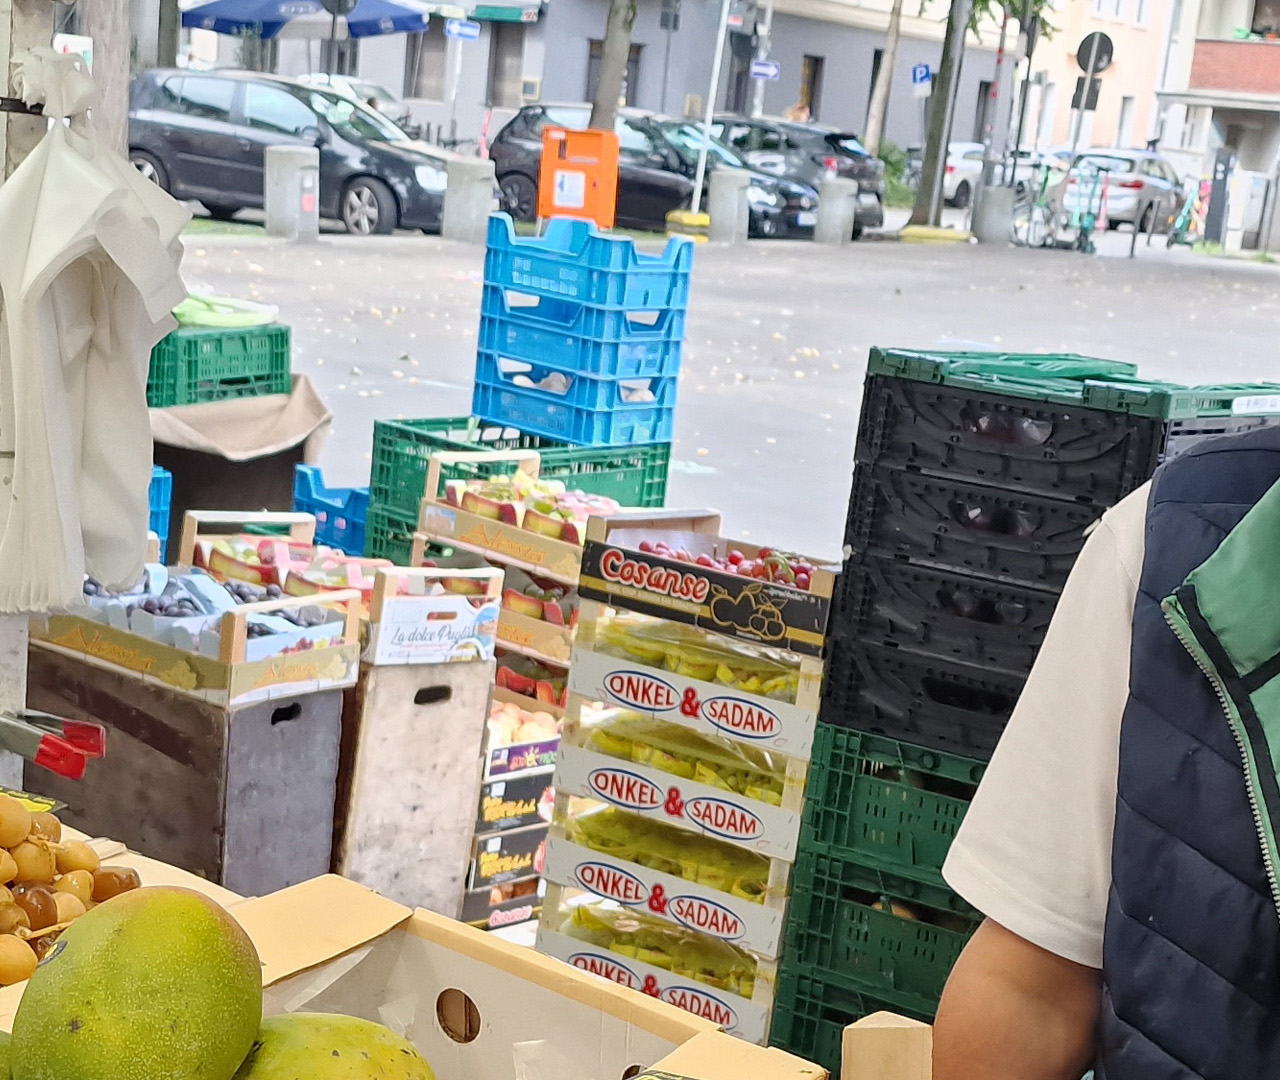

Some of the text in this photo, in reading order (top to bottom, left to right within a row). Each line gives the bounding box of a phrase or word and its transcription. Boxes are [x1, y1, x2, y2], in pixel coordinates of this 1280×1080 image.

[601, 549, 710, 603] Cosanse
[609, 675, 774, 732] ONKEL & SADAM
[594, 772, 756, 834] ONKEL & SADAM
[581, 866, 738, 935] ONKEL & SADAM
